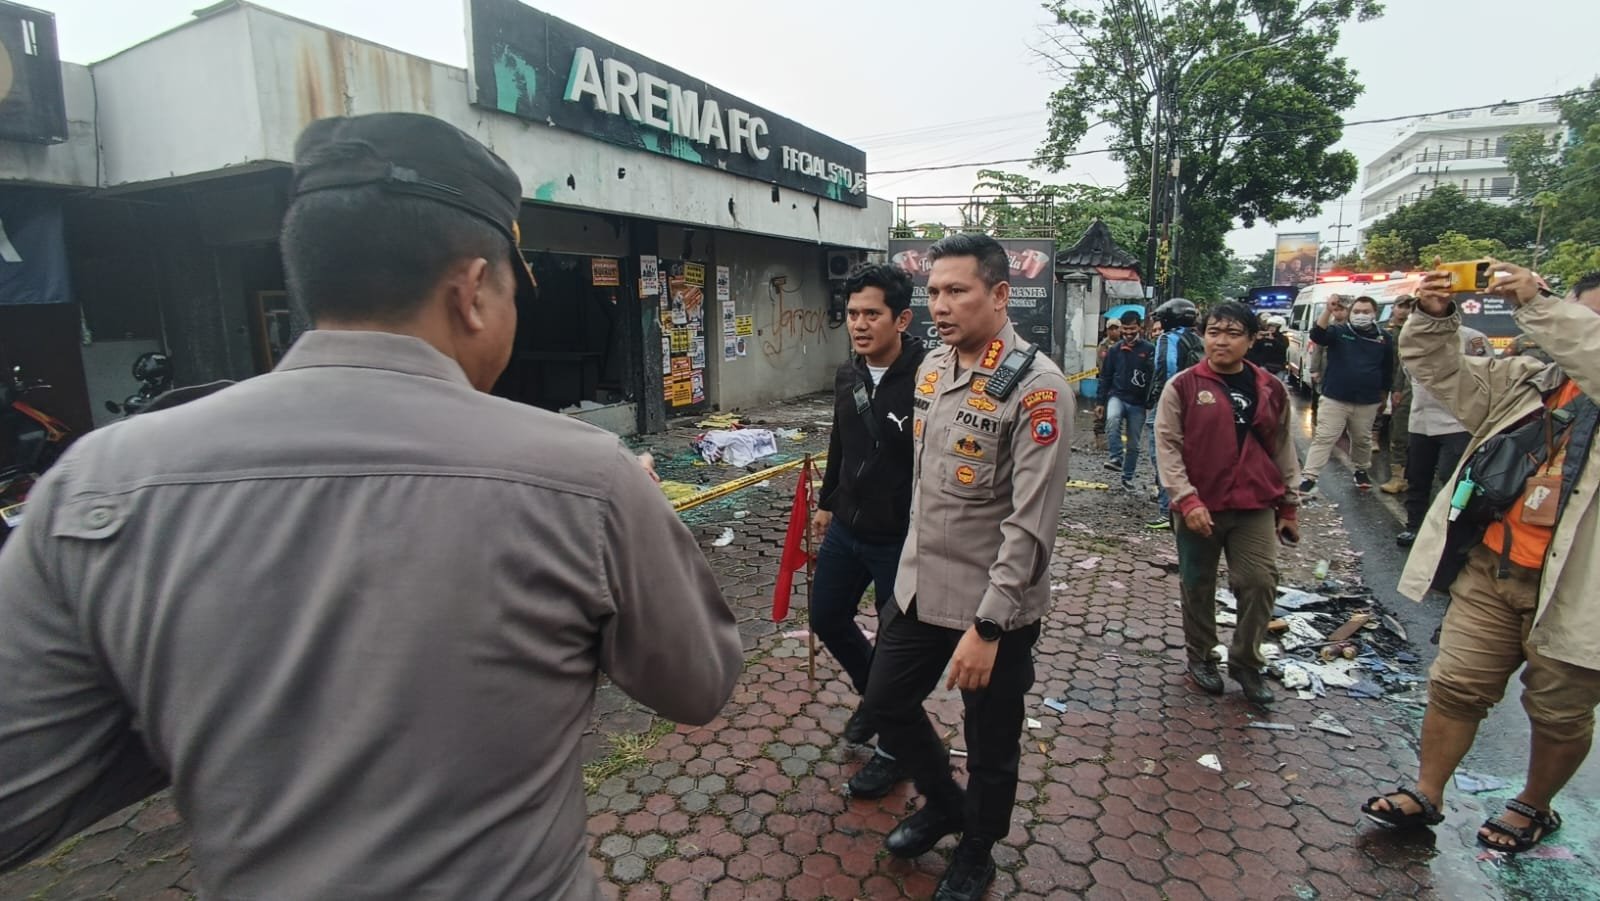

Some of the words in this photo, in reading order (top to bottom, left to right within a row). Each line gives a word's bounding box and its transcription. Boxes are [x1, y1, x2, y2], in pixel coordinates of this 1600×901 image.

[563, 46, 728, 150] AREMA
[728, 108, 770, 161] FC
[955, 410, 997, 433] POLRI
